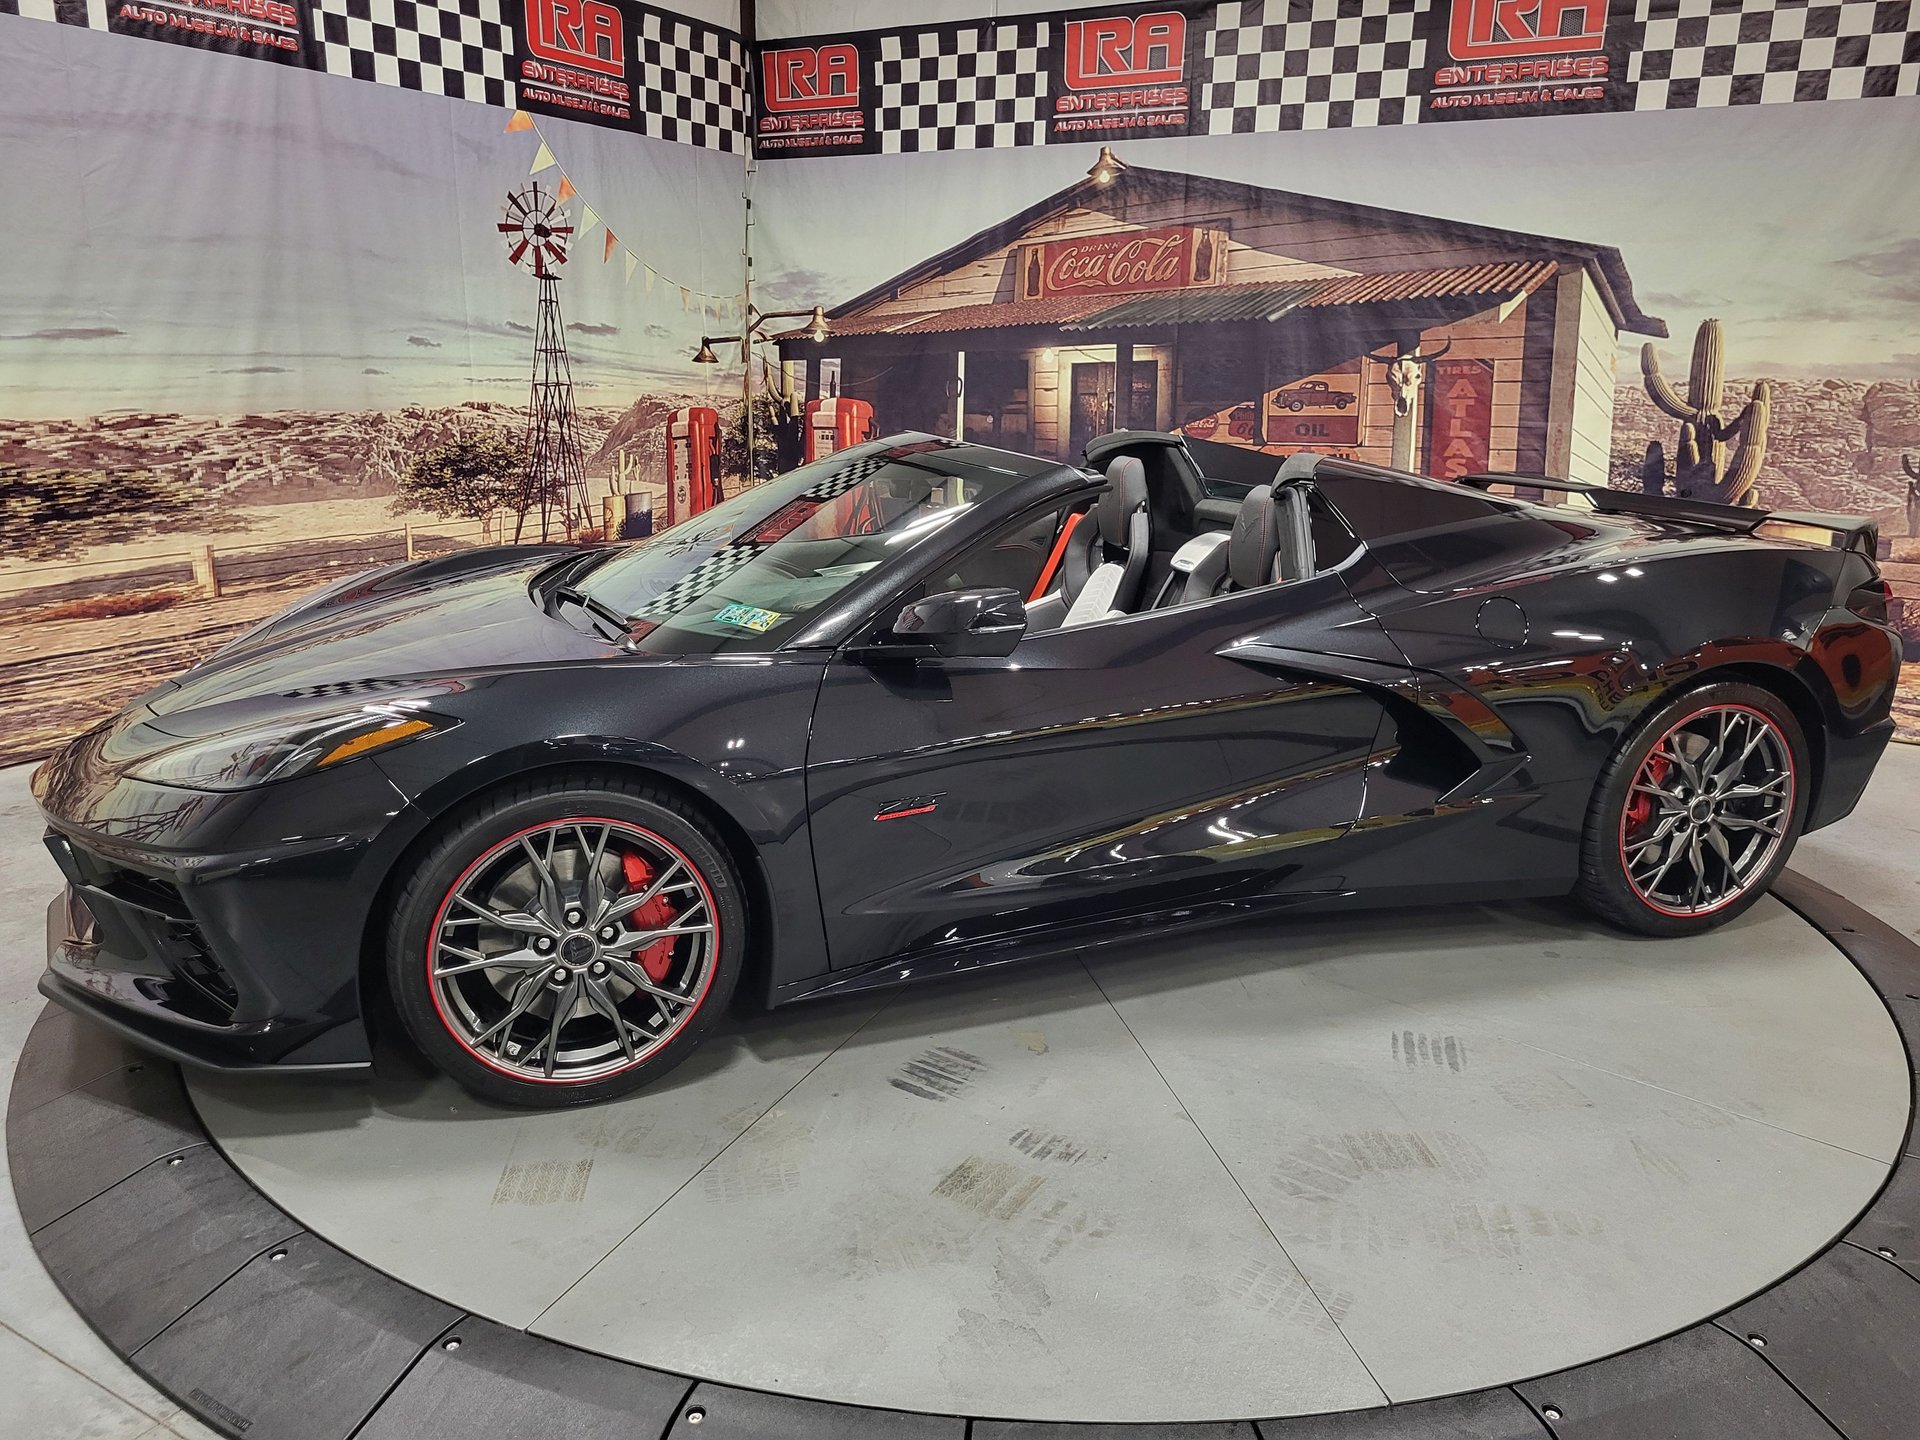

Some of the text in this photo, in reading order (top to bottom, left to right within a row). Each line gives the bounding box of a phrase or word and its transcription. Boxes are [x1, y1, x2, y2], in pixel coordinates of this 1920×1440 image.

[120, 4, 299, 52] AUTO MUSEUM & SALES
[522, 60, 630, 100] ENTERPRISES
[1434, 56, 1610, 86] ENTERPRISES
[522, 88, 631, 119] AUTO MUSEUM & SALES
[1056, 87, 1188, 112] ENTERPRISES
[1430, 86, 1604, 109] AUTO MUSEUM & SALES
[760, 111, 864, 132] ENTERPRISES
[1054, 113, 1185, 132] AUTO MUSEUM & SALES
[759, 139, 784, 149] AUTO
[1080, 241, 1121, 253] DRINK
[1046, 234, 1186, 291] Coca-Cola
[1437, 366, 1482, 375] TIRES
[1294, 423, 1330, 438] OIL
[1443, 378, 1478, 478] ATLAS
